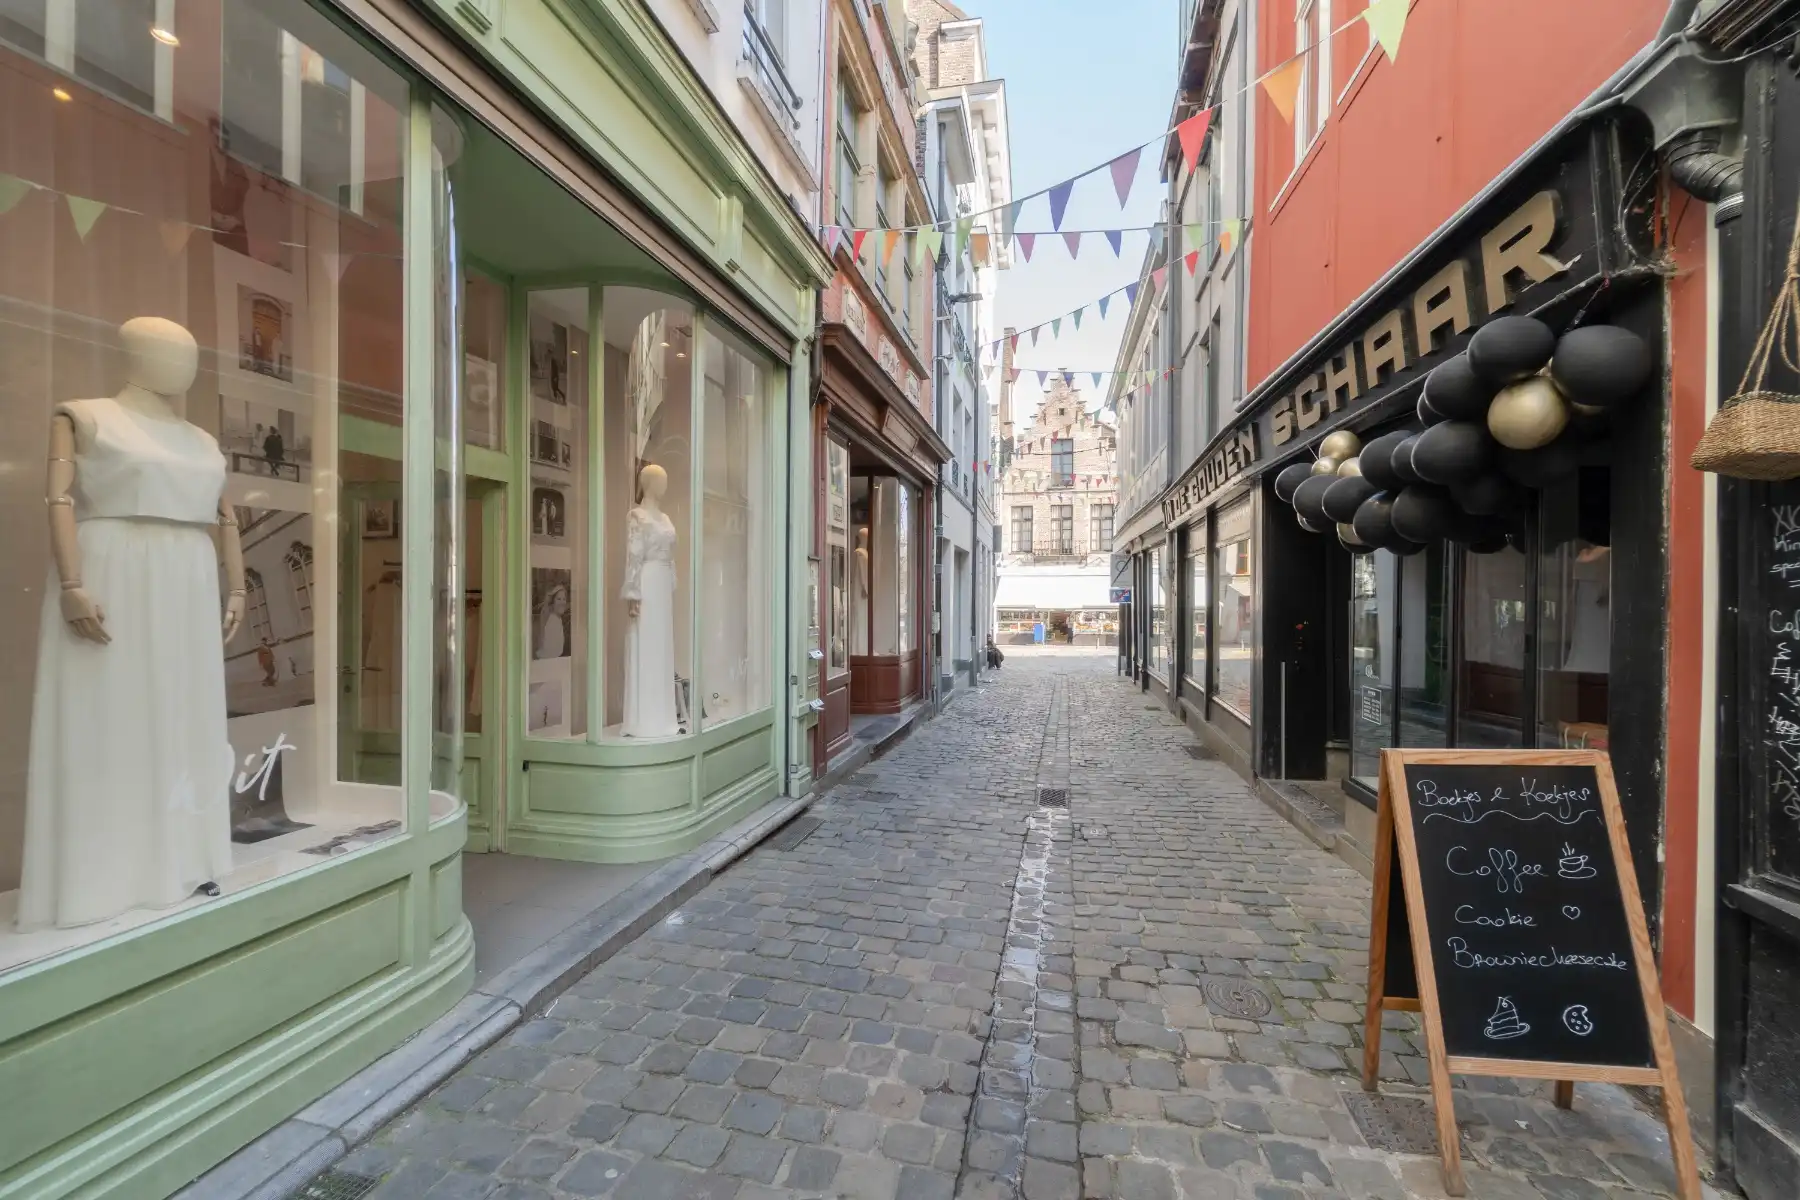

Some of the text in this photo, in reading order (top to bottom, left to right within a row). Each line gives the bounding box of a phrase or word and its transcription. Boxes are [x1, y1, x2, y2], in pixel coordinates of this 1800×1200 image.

[1175, 488, 1187, 516] DE
[1191, 424, 1257, 502] GOUDEN
[1271, 191, 1575, 447] SCHAAR
[1520, 777, 1591, 818] Koekjes
[1446, 845, 1549, 893] Coffee
[1454, 904, 1537, 927] Cookie
